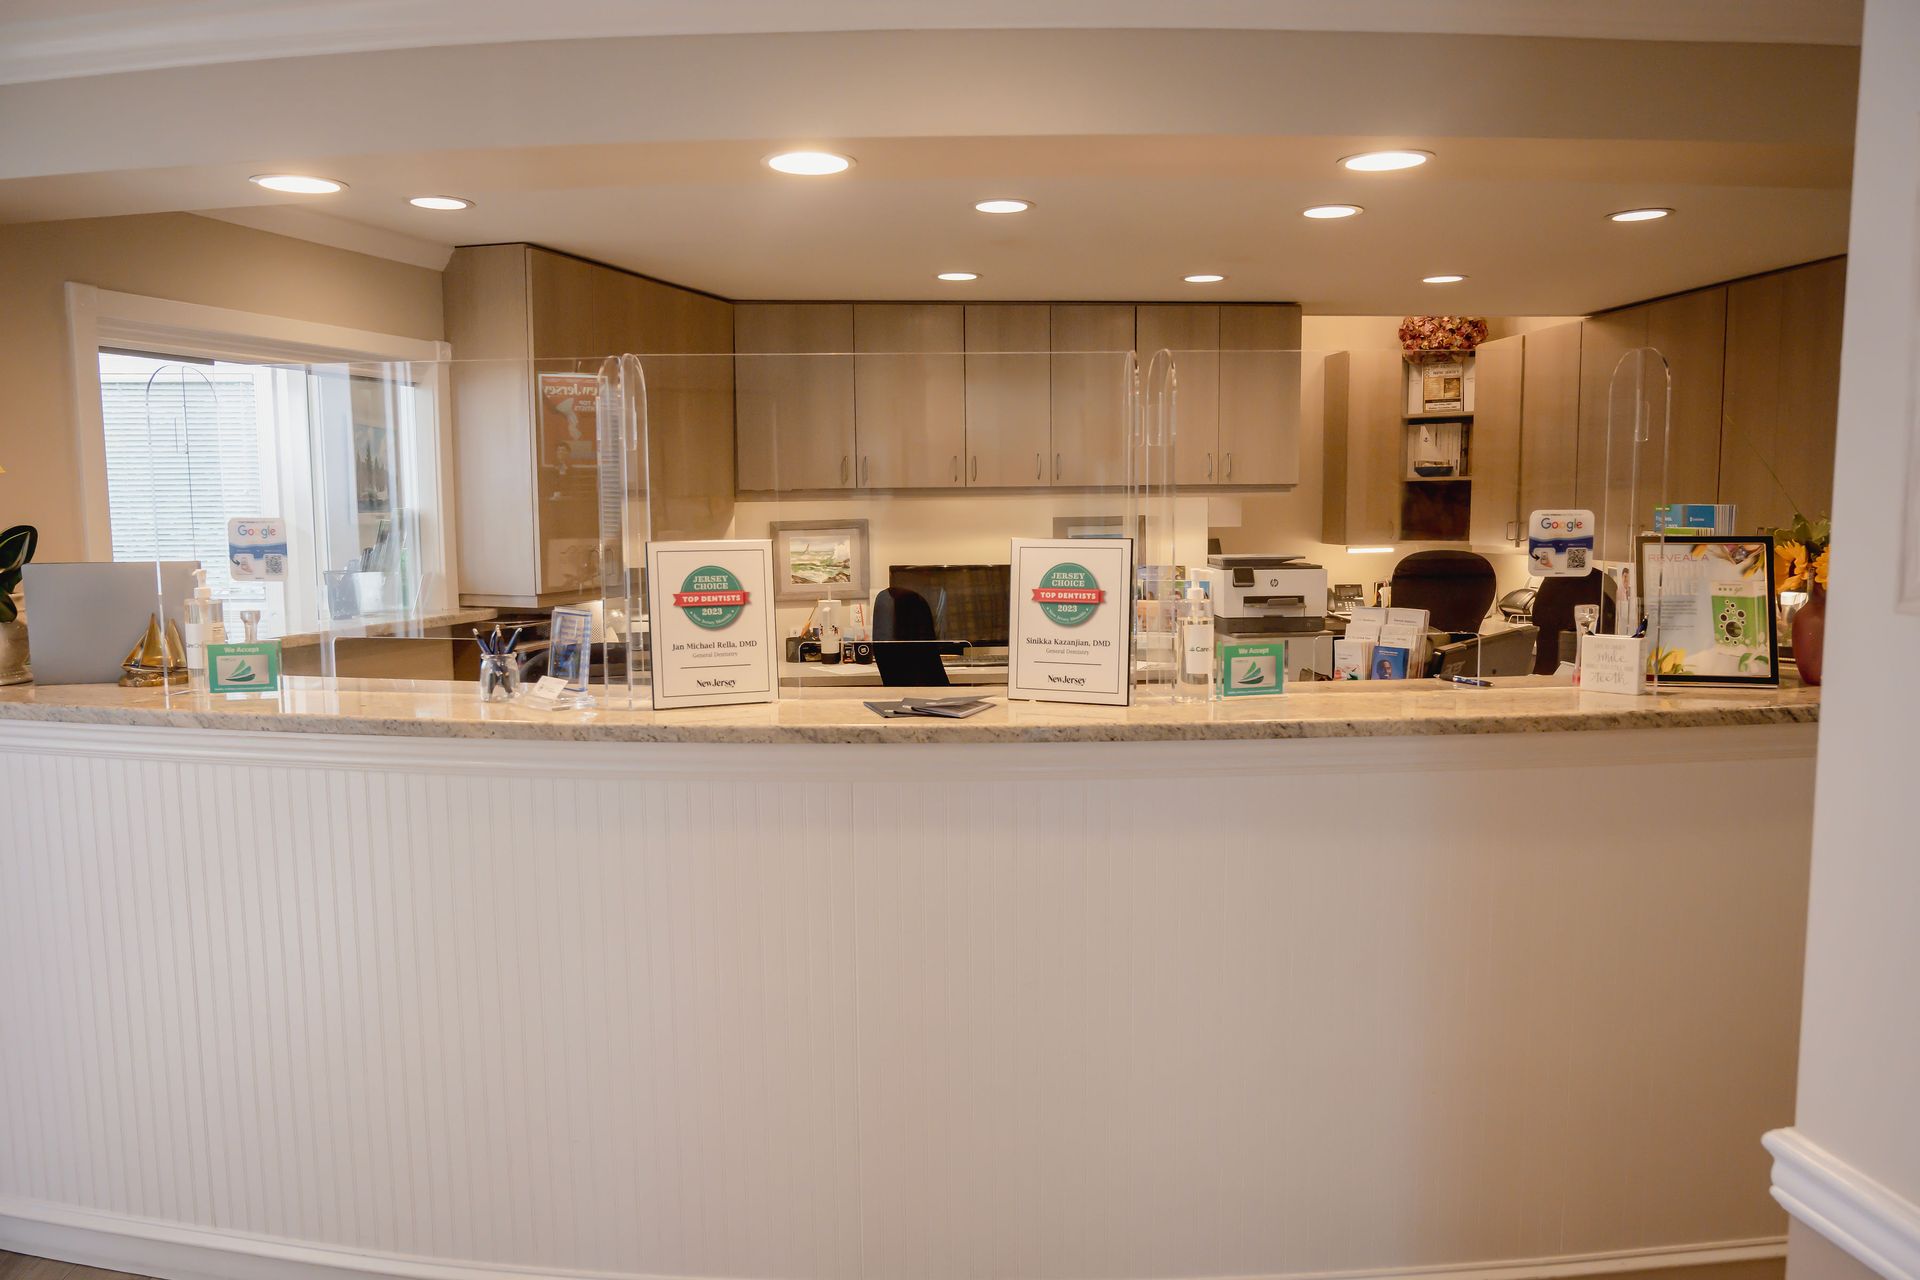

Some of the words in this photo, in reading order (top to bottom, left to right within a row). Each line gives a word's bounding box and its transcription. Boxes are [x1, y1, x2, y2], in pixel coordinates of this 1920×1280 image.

[1540, 517, 1583, 532] Google
[237, 524, 276, 539] Google
[1648, 553, 1698, 562] REVEAL
[1702, 553, 1710, 561] A
[692, 575, 729, 583] JERSEY
[1051, 572, 1086, 580] JERSEY
[693, 582, 729, 590] CHOICE
[1051, 579, 1086, 587] CHOICE
[682, 595, 700, 603] TOP
[701, 594, 741, 602] DENTISTS
[1057, 592, 1096, 600] DENTISTS
[701, 607, 723, 616] 2023
[1057, 604, 1078, 613] 2023
[672, 643, 685, 651] Jan
[686, 641, 715, 650] Michael
[716, 640, 738, 649] Rella,
[739, 640, 757, 648] DMD
[1026, 637, 1052, 645] Sinikka
[1053, 638, 1091, 647] Kazanjian,
